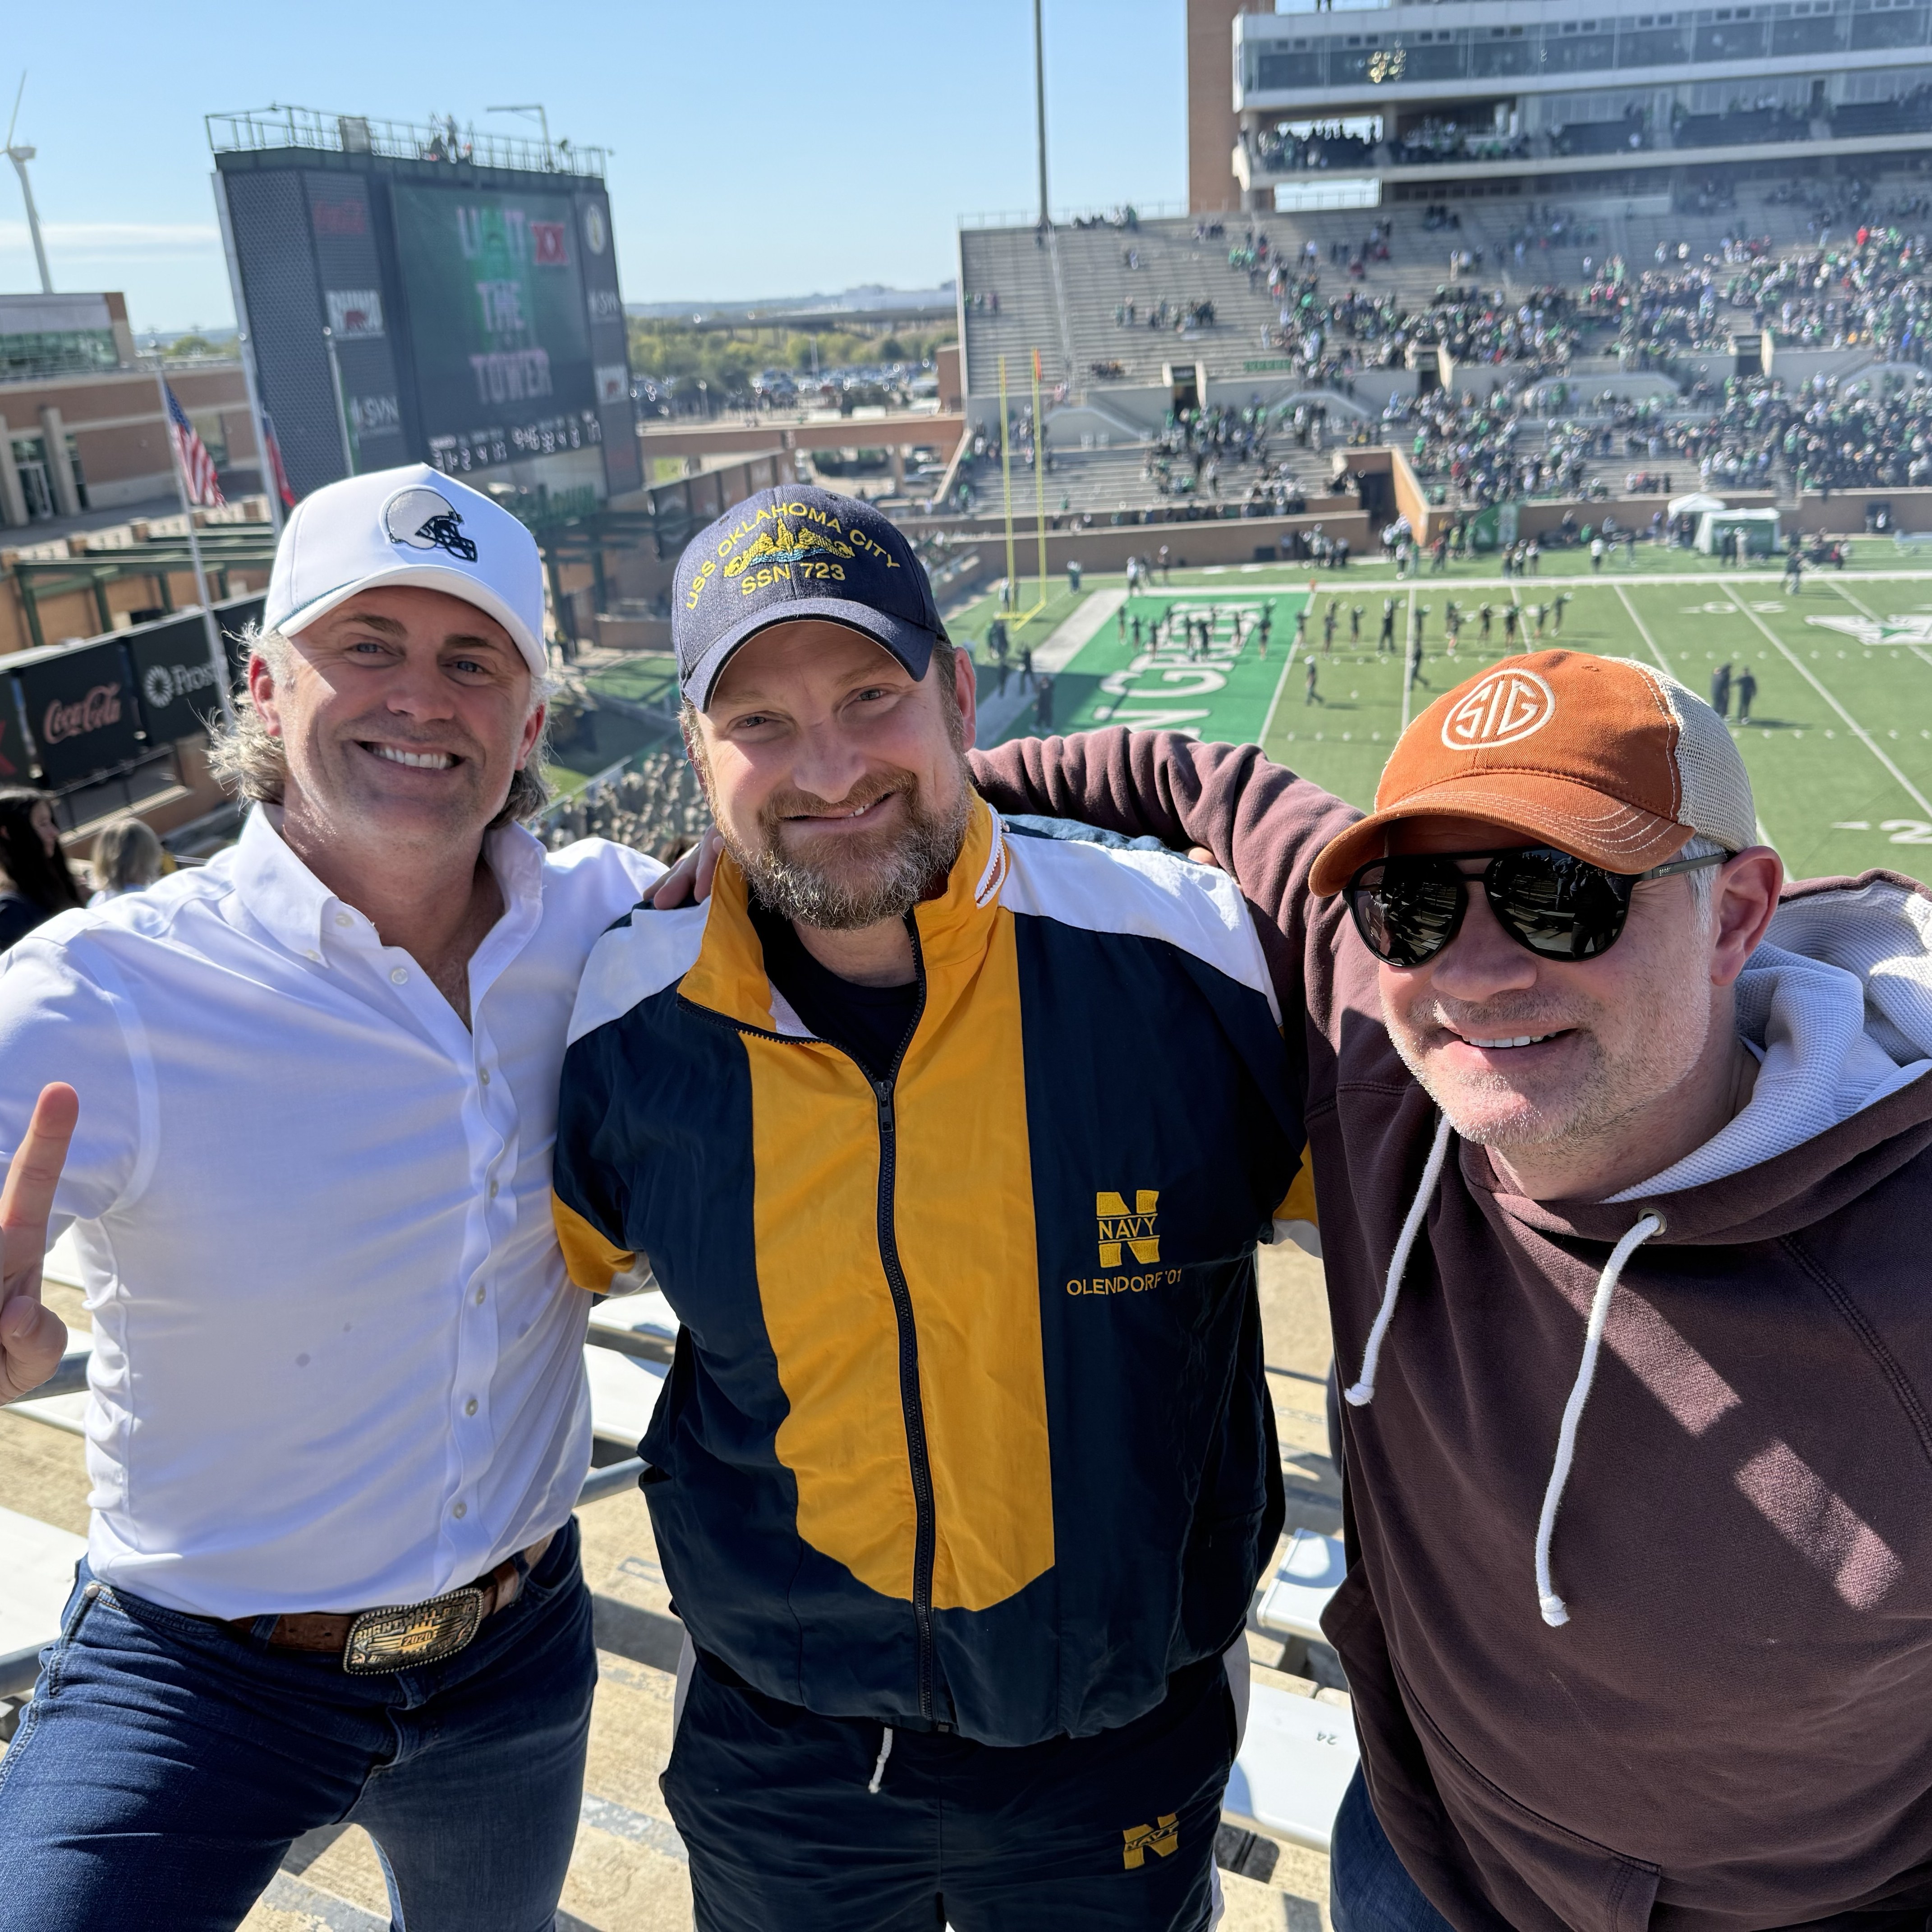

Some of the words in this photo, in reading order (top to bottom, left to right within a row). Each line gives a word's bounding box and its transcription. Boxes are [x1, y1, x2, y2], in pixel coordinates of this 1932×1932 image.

[686, 560, 716, 610] USS
[718, 502, 842, 557] OKLAHOMA
[849, 529, 901, 569] CITY
[742, 564, 791, 596] SSN
[800, 562, 846, 580] 723
[1455, 680, 1540, 739] SIG
[1099, 1217, 1156, 1240] NAVY
[1067, 1272, 1163, 1295] OLENDORF
